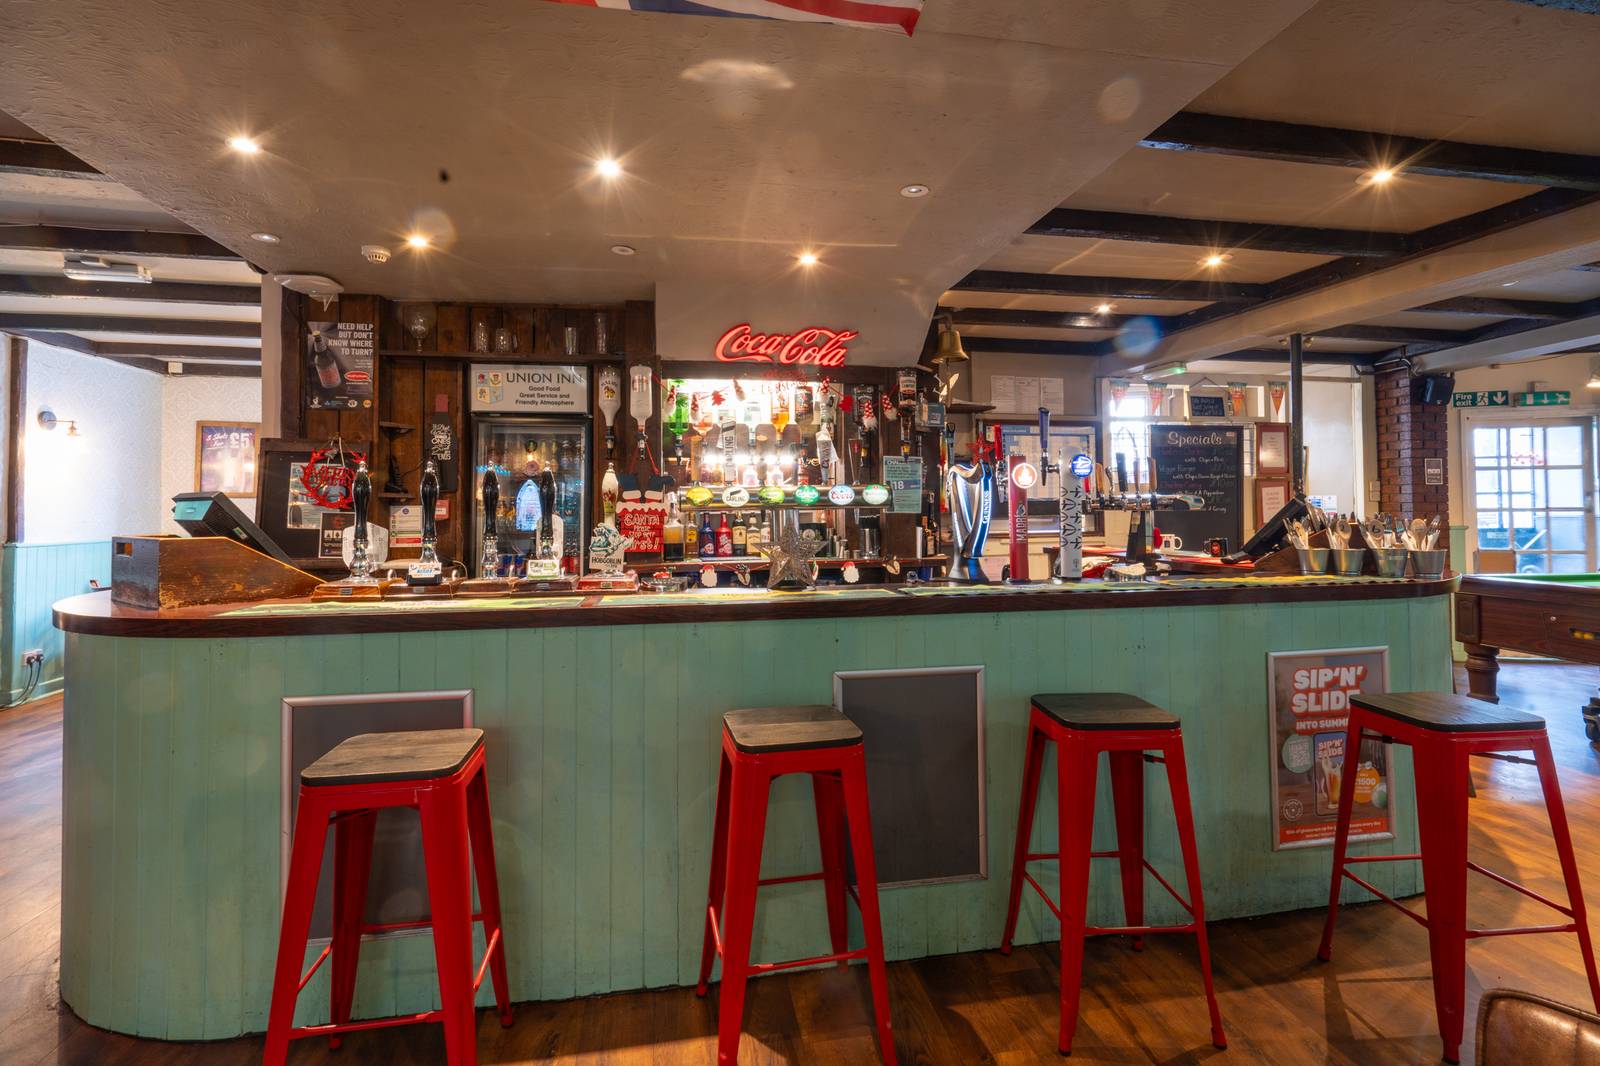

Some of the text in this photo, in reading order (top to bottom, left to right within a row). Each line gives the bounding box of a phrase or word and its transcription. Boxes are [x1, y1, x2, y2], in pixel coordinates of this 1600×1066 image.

[337, 322, 374, 331] NEED HELP
[350, 340, 374, 348] WHERE
[716, 324, 858, 368] Coca-Cola
[351, 348, 373, 356] TURN?
[506, 372, 552, 383] UNION
[1167, 431, 1222, 448] Specials
[892, 480, 905, 490] 18
[623, 513, 660, 526] SANTA
[1294, 666, 1364, 690] SIP'N'
[1296, 720, 1318, 730] INTO
